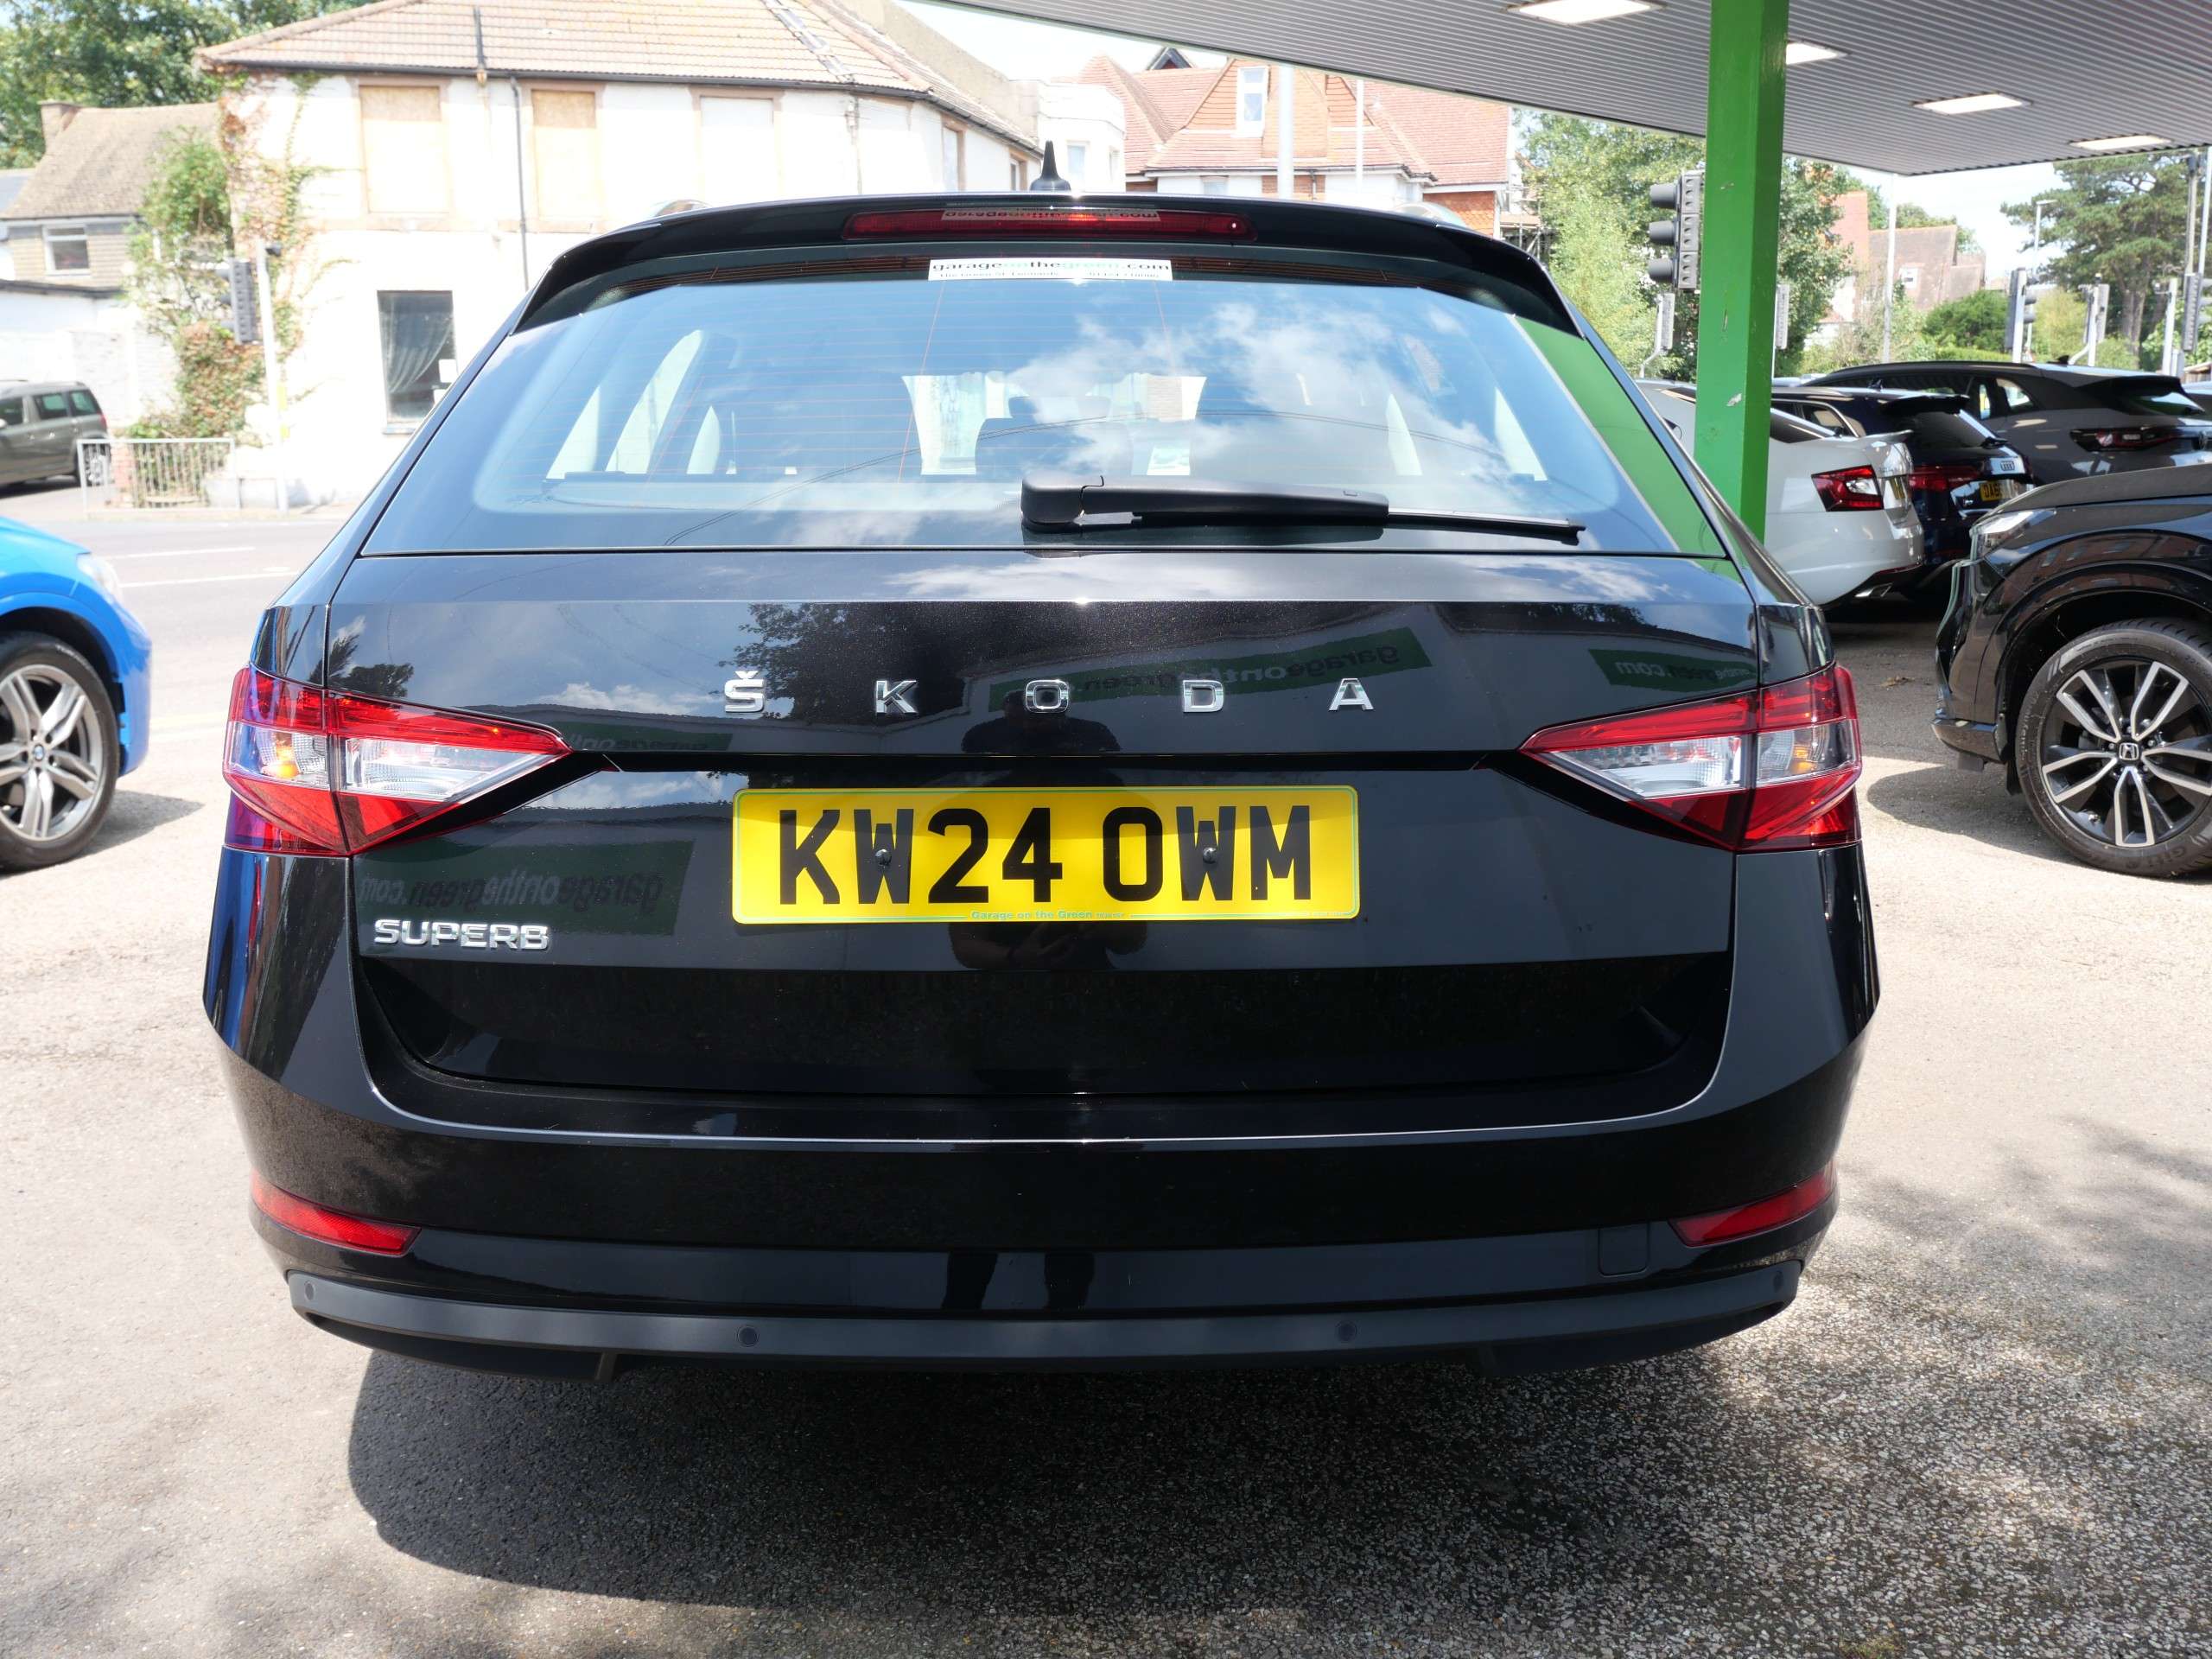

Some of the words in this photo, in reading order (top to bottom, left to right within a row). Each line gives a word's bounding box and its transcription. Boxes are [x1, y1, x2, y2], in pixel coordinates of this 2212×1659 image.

[779, 807, 1064, 906] KW24
[1102, 805, 1312, 903] OWM
[971, 911, 1014, 920] Garage
[1036, 910, 1054, 919] the
[1058, 910, 1093, 919] Green
[374, 919, 550, 950] SUPERB
